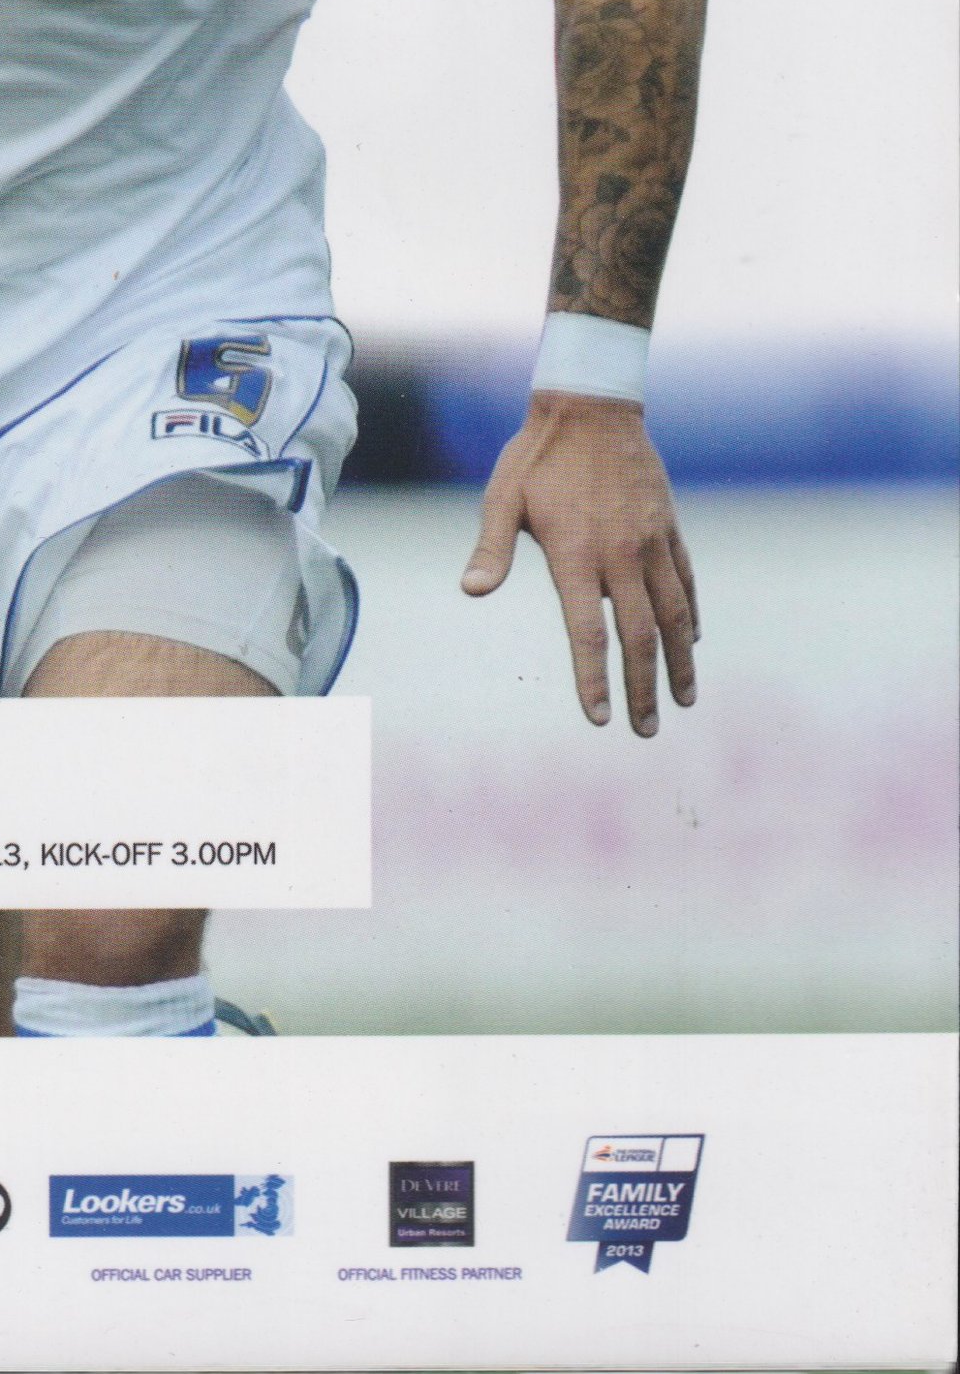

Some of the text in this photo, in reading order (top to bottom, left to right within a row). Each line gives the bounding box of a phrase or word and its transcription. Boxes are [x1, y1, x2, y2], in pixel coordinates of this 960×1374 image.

[164, 413, 262, 459] FILA
[40, 842, 163, 867] KICK-OFF
[170, 842, 277, 866] 3.00PM
[587, 1182, 686, 1203] FAMILY
[397, 1207, 468, 1219] VILLAGE
[583, 1204, 681, 1217] EXCELLENCE
[61, 1216, 143, 1226] Customers for Life
[603, 1218, 662, 1230] AWARD
[397, 1229, 466, 1237] Urban Resorts
[605, 1245, 645, 1257] 2013
[91, 1268, 252, 1281] OFFICIAL CAR SUPPLIER
[338, 1267, 522, 1281] OFFICIAL FITNESS PARTNER
